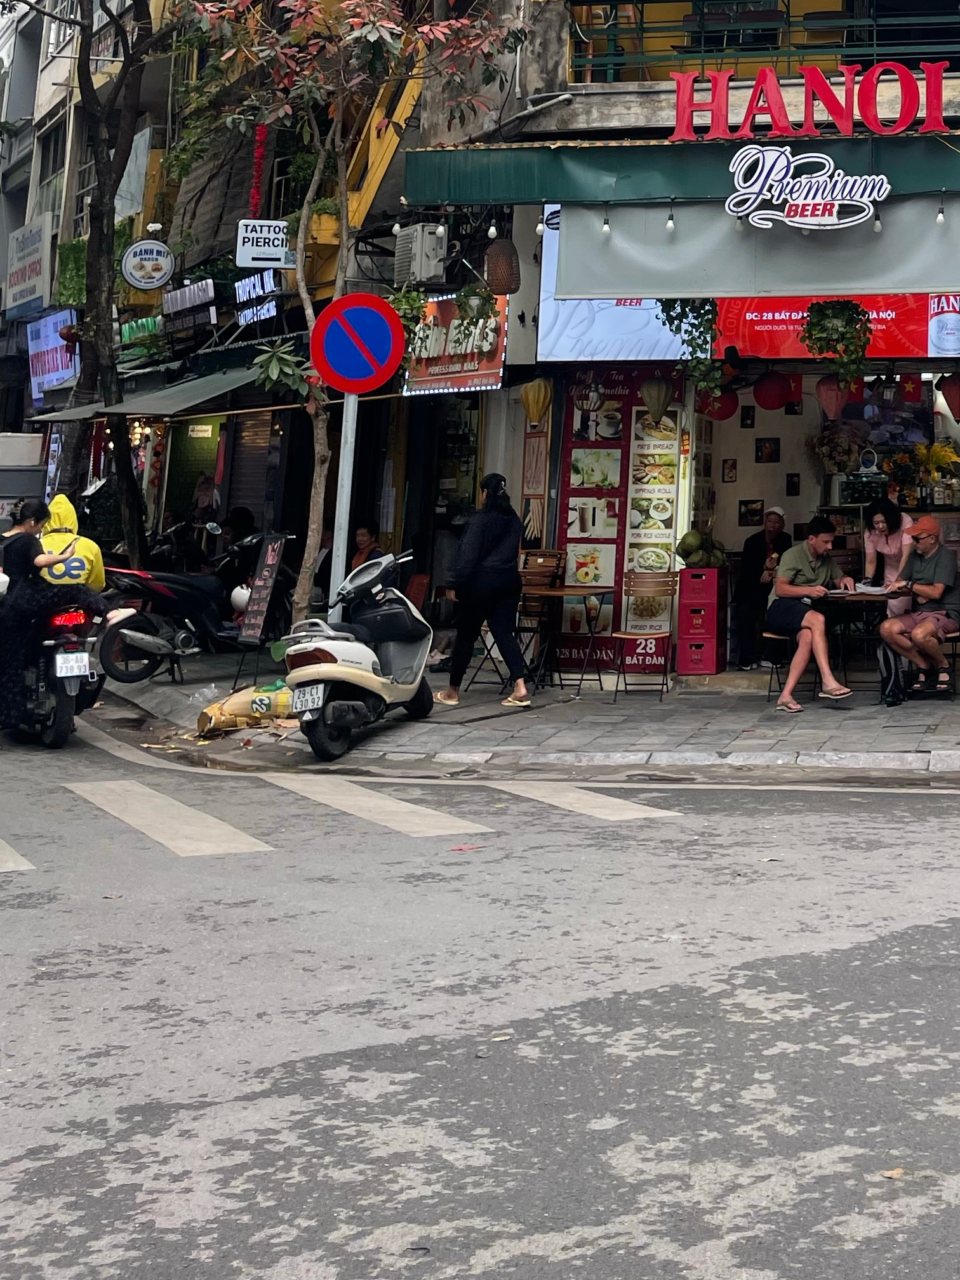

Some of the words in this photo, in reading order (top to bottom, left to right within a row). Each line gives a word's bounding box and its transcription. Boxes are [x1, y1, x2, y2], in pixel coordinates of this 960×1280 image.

[668, 61, 950, 141] HANOI
[726, 145, 893, 216] Premium
[784, 202, 836, 219] BEER
[242, 237, 287, 248] PIERCI
[762, 312, 773, 320] 28
[774, 310, 790, 320] BÁT
[879, 310, 896, 321] NỘI
[609, 371, 624, 380] Tea
[636, 639, 656, 654] 28
[625, 653, 644, 665] BÁT
[645, 653, 665, 665] ĐÀN
[297, 685, 320, 700] 29-C1
